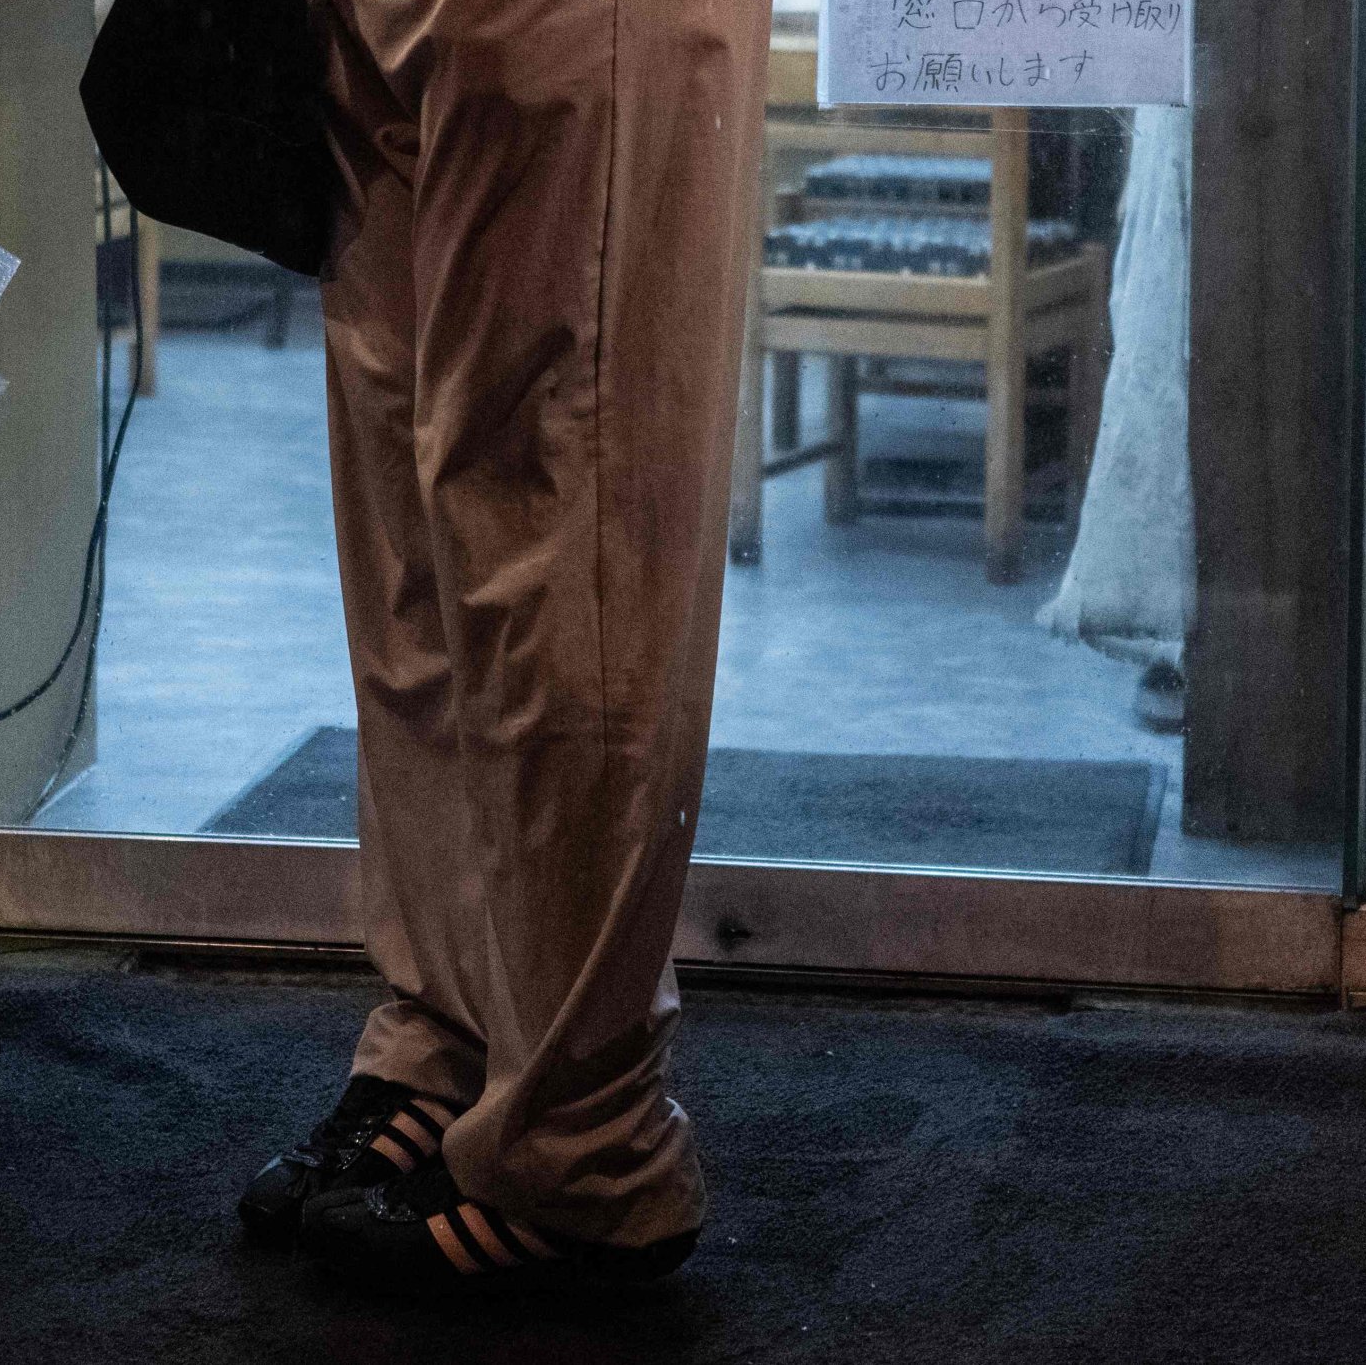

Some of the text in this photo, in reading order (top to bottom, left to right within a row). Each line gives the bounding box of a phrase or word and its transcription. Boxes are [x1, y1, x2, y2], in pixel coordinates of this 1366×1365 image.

[870, 49, 1094, 92] お願いします
